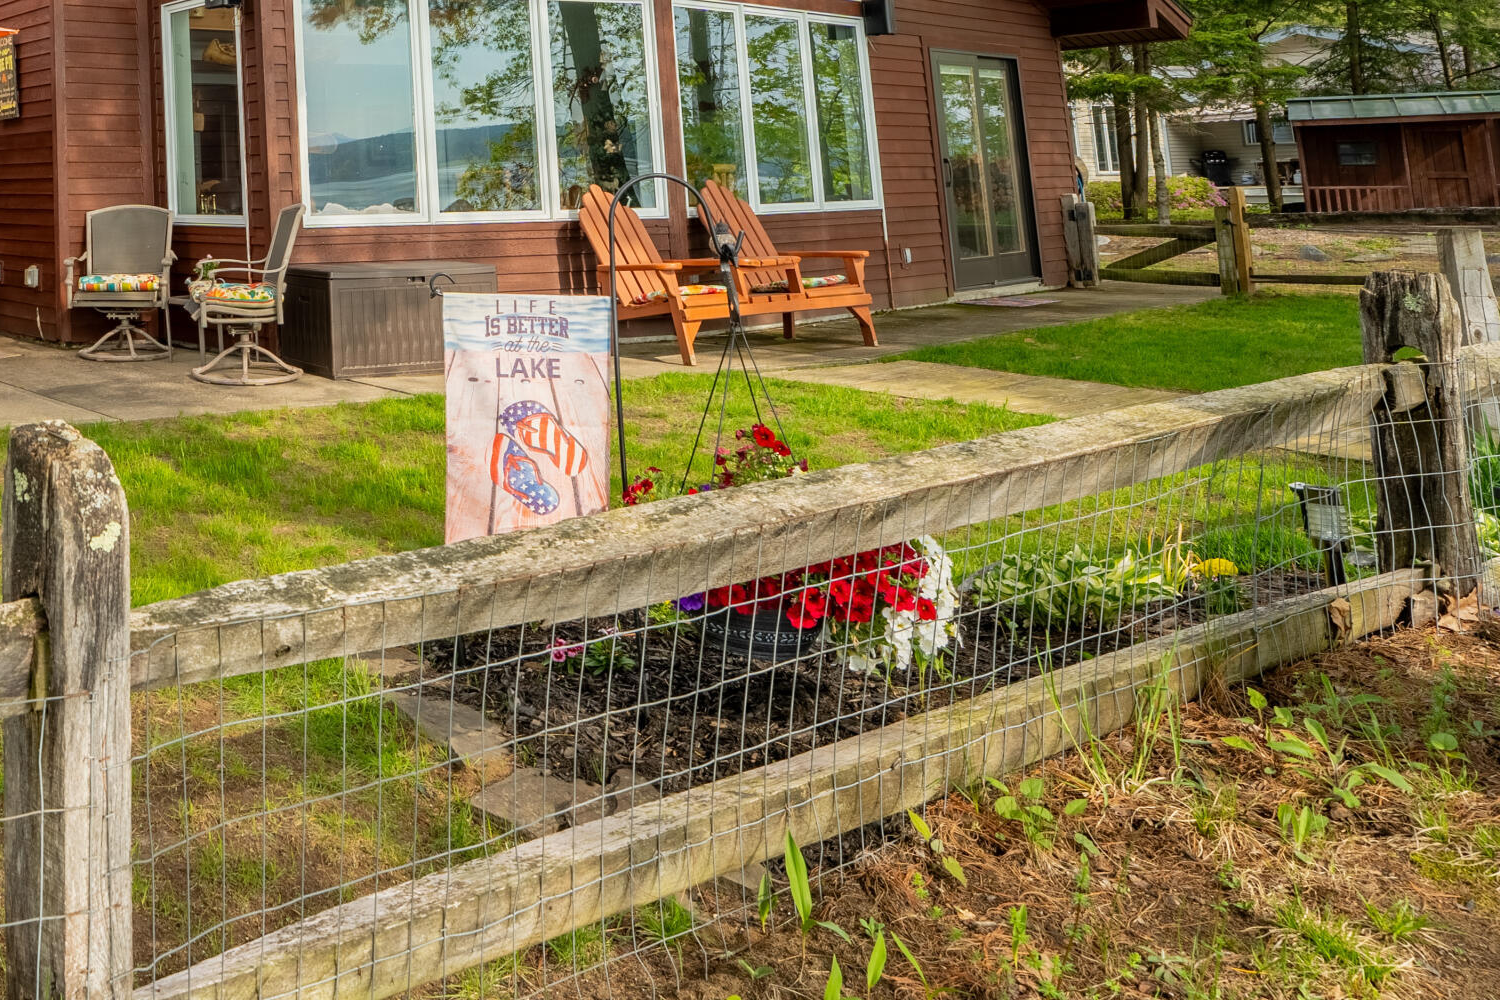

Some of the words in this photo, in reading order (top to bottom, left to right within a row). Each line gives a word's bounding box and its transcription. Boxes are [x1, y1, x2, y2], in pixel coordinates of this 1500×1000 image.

[496, 299, 557, 316] LIFE
[484, 315, 501, 337] IS
[506, 315, 569, 339] BETTER
[504, 336, 522, 352] at
[527, 335, 551, 352] the
[495, 357, 562, 379] LAKE
